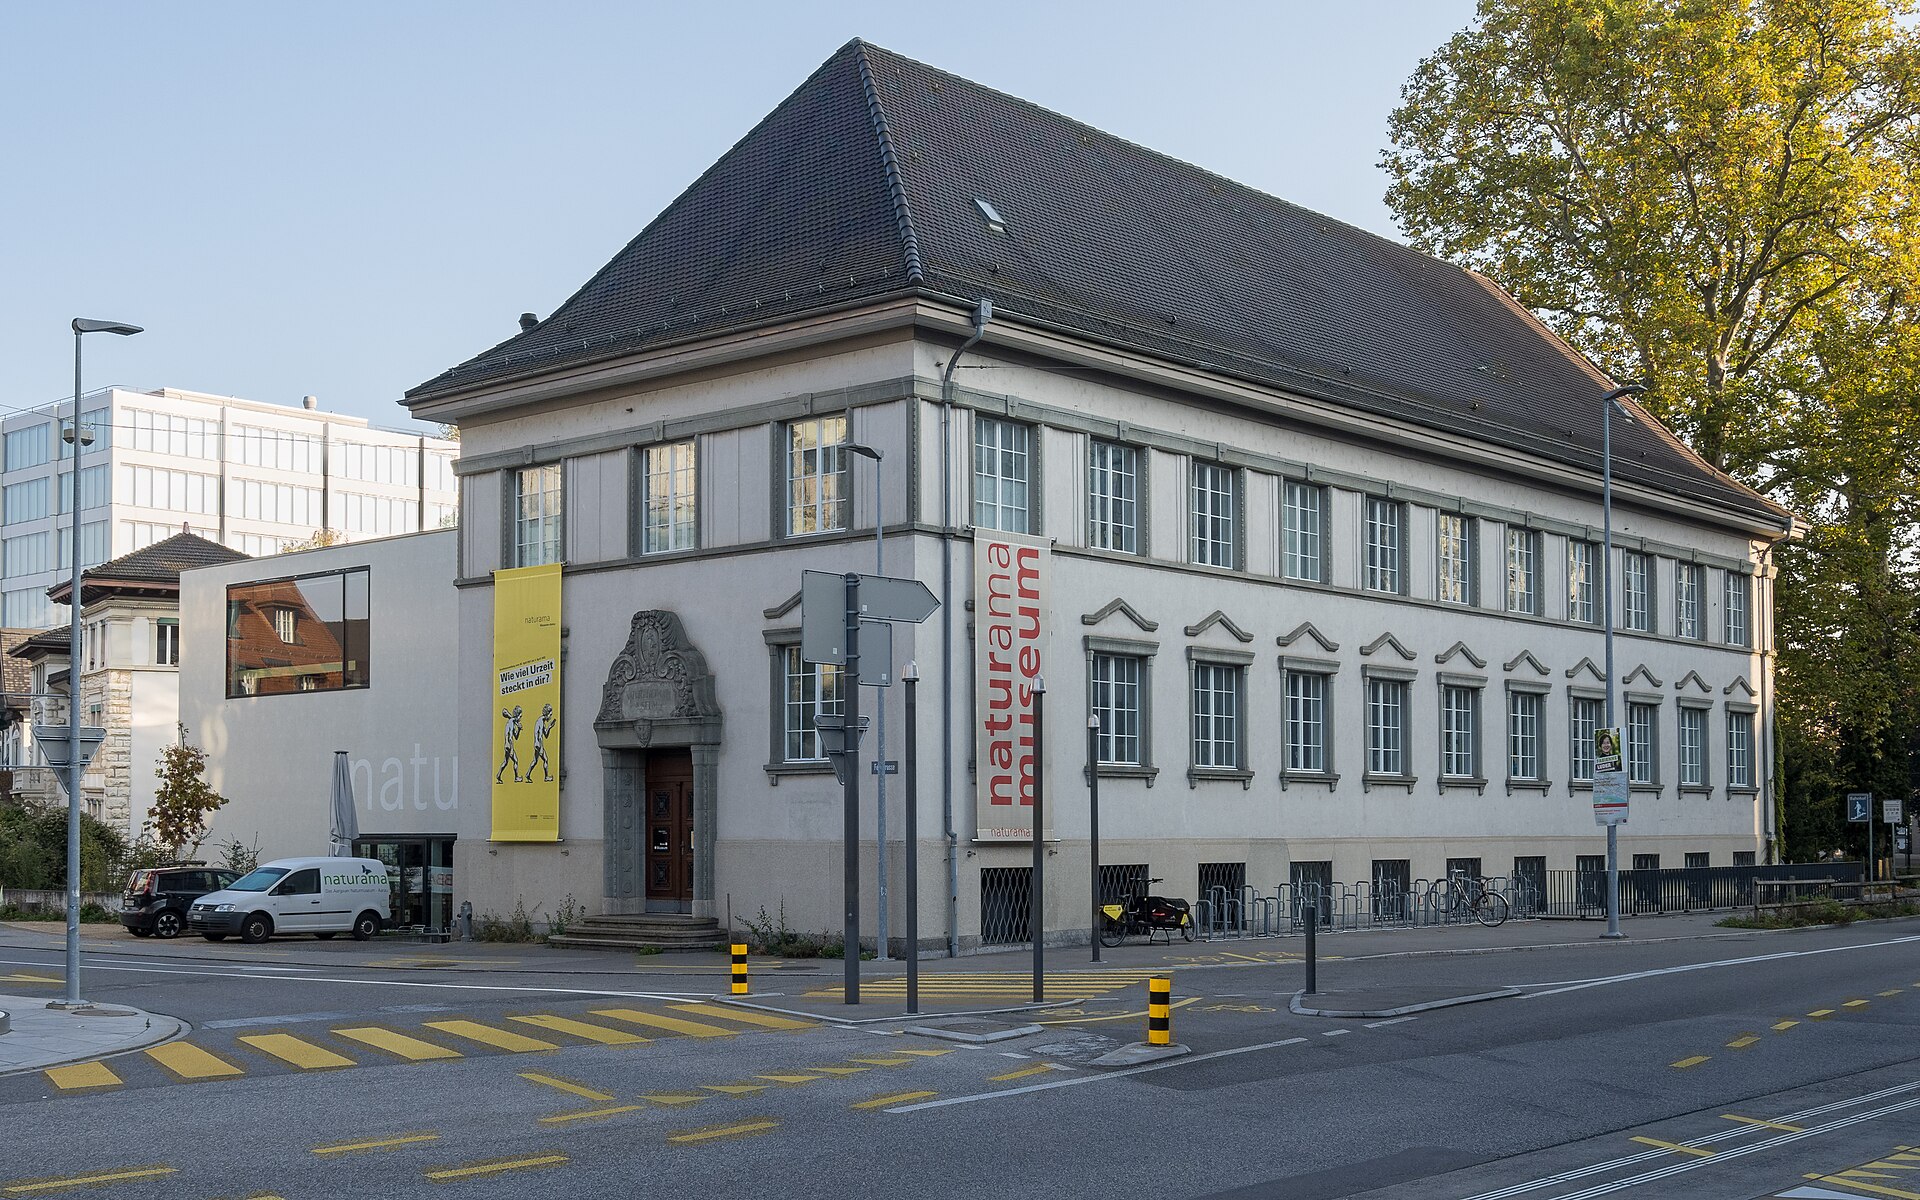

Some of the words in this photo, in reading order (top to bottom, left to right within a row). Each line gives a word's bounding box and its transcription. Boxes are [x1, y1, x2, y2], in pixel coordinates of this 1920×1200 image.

[525, 615, 551, 624] naturama
[500, 671, 515, 682] Wie
[515, 667, 529, 679] viel
[530, 661, 554, 674] Urzeit
[984, 543, 1013, 806] naturama
[501, 681, 525, 695] steckt
[526, 679, 534, 688] in
[535, 674, 551, 685] dir?
[350, 743, 458, 811] natu
[990, 826, 1031, 838] naturama
[324, 874, 387, 885] naturama
